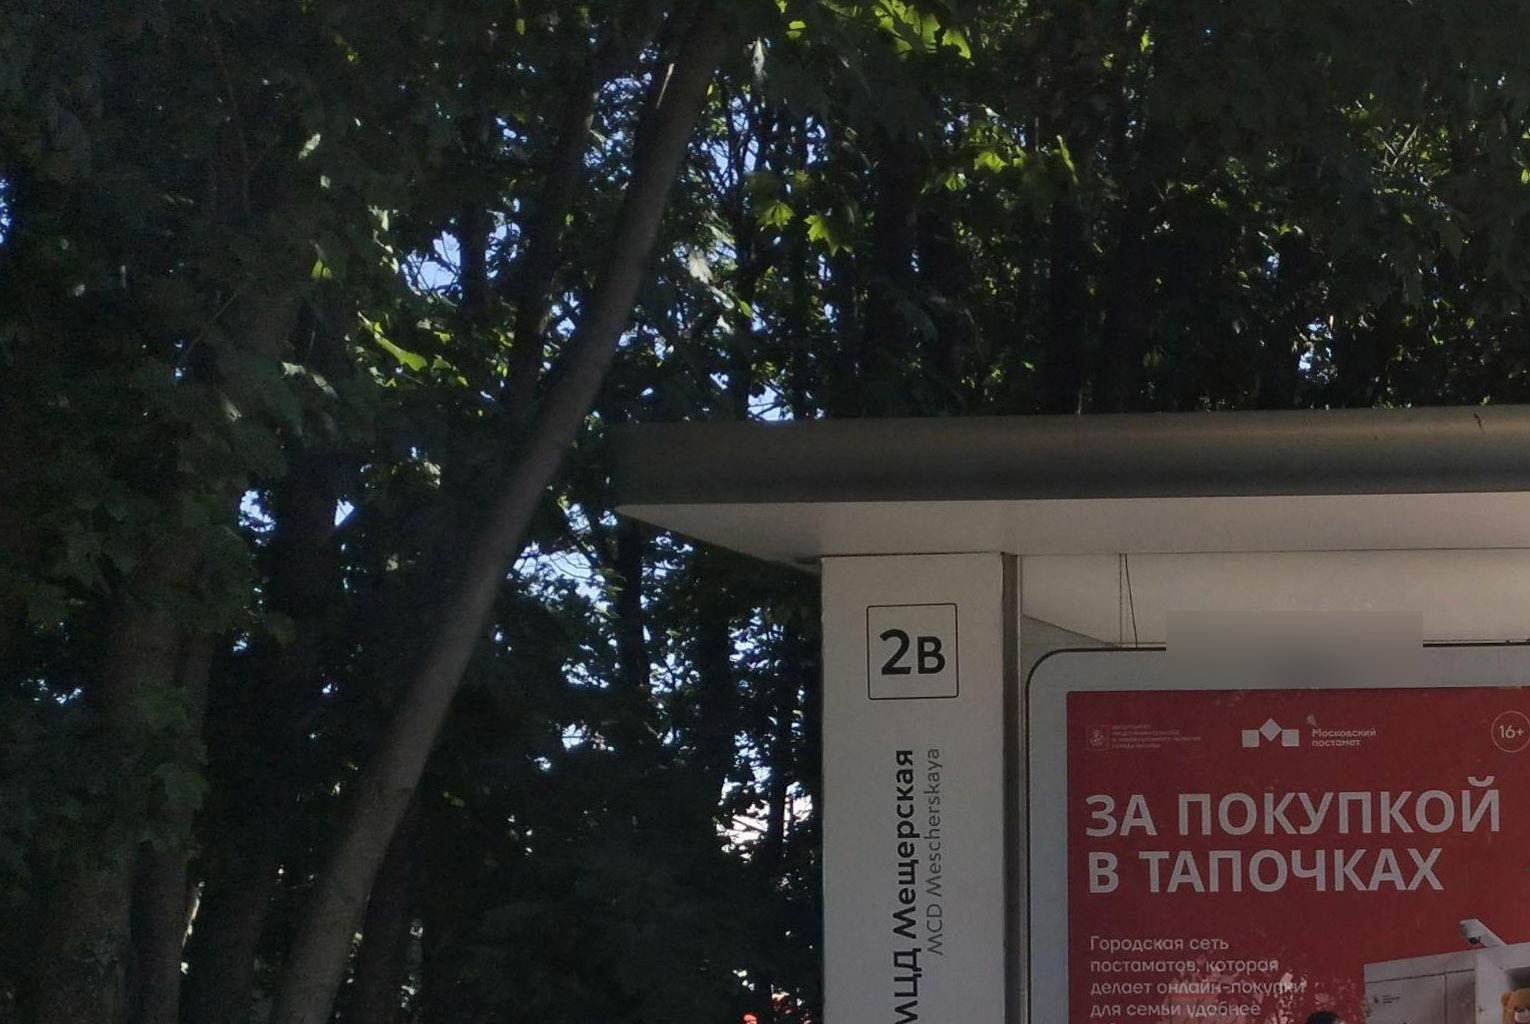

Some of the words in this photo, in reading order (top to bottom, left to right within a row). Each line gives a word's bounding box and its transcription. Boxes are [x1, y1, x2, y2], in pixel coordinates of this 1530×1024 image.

[1312, 728, 1376, 738] Московский
[1499, 724, 1525, 738] 16+
[1312, 739, 1361, 748] постамат
[1085, 793, 1158, 836] ЗА
[1177, 775, 1500, 835] ПОКУПКОЙ
[923, 748, 943, 897] Mescherskaya
[892, 750, 920, 939] Мещерская
[1088, 851, 1119, 894] В
[1138, 847, 1444, 893] ТАПОЧКАХ
[926, 903, 944, 955] MCD
[1090, 936, 1184, 953] Городская
[1189, 938, 1229, 951] сеть
[1090, 960, 1200, 973] постаматов,
[1206, 959, 1279, 975] которая
[1090, 982, 1153, 995] делает
[1156, 979, 1306, 997] онлайн-покупки
[1090, 1004, 1121, 1018] для
[1126, 1003, 1181, 1016] семьи
[1186, 1001, 1261, 1018] удобнее
